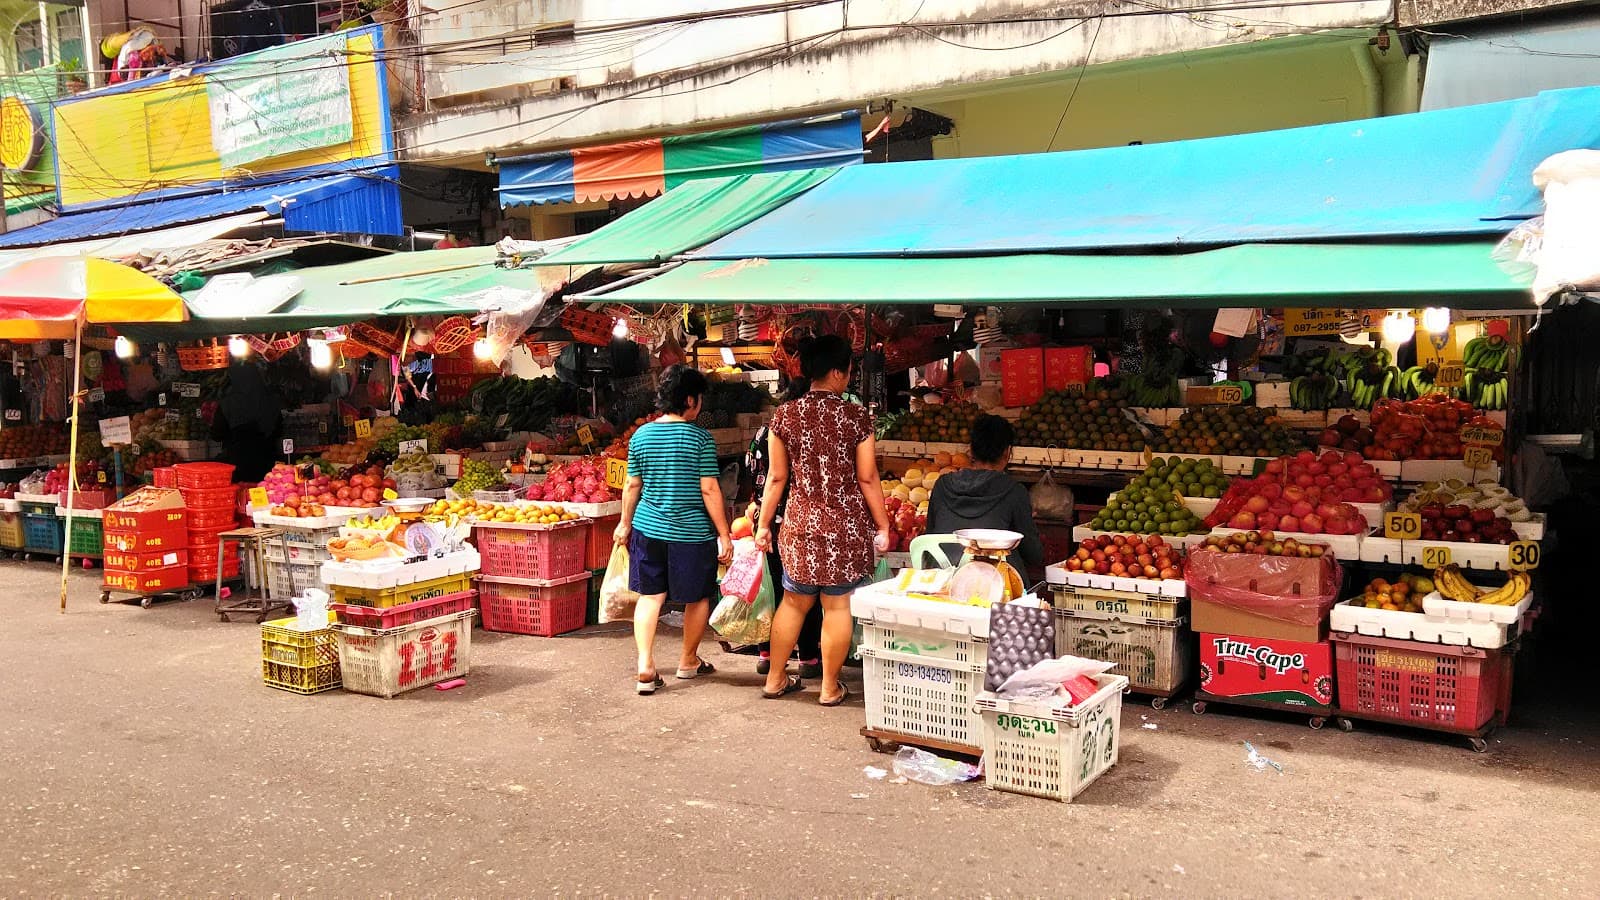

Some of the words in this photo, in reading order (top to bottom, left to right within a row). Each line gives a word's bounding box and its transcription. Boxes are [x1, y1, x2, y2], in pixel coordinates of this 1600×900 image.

[1221, 388, 1241, 402] 150
[358, 421, 369, 436] 15
[1467, 449, 1491, 465] 150
[610, 461, 625, 486] 50
[1390, 515, 1417, 535] 50
[1426, 549, 1447, 565] 20
[1512, 544, 1538, 566] 30
[1214, 638, 1304, 675] Tru-Cape
[898, 662, 952, 685] 093-1342550
